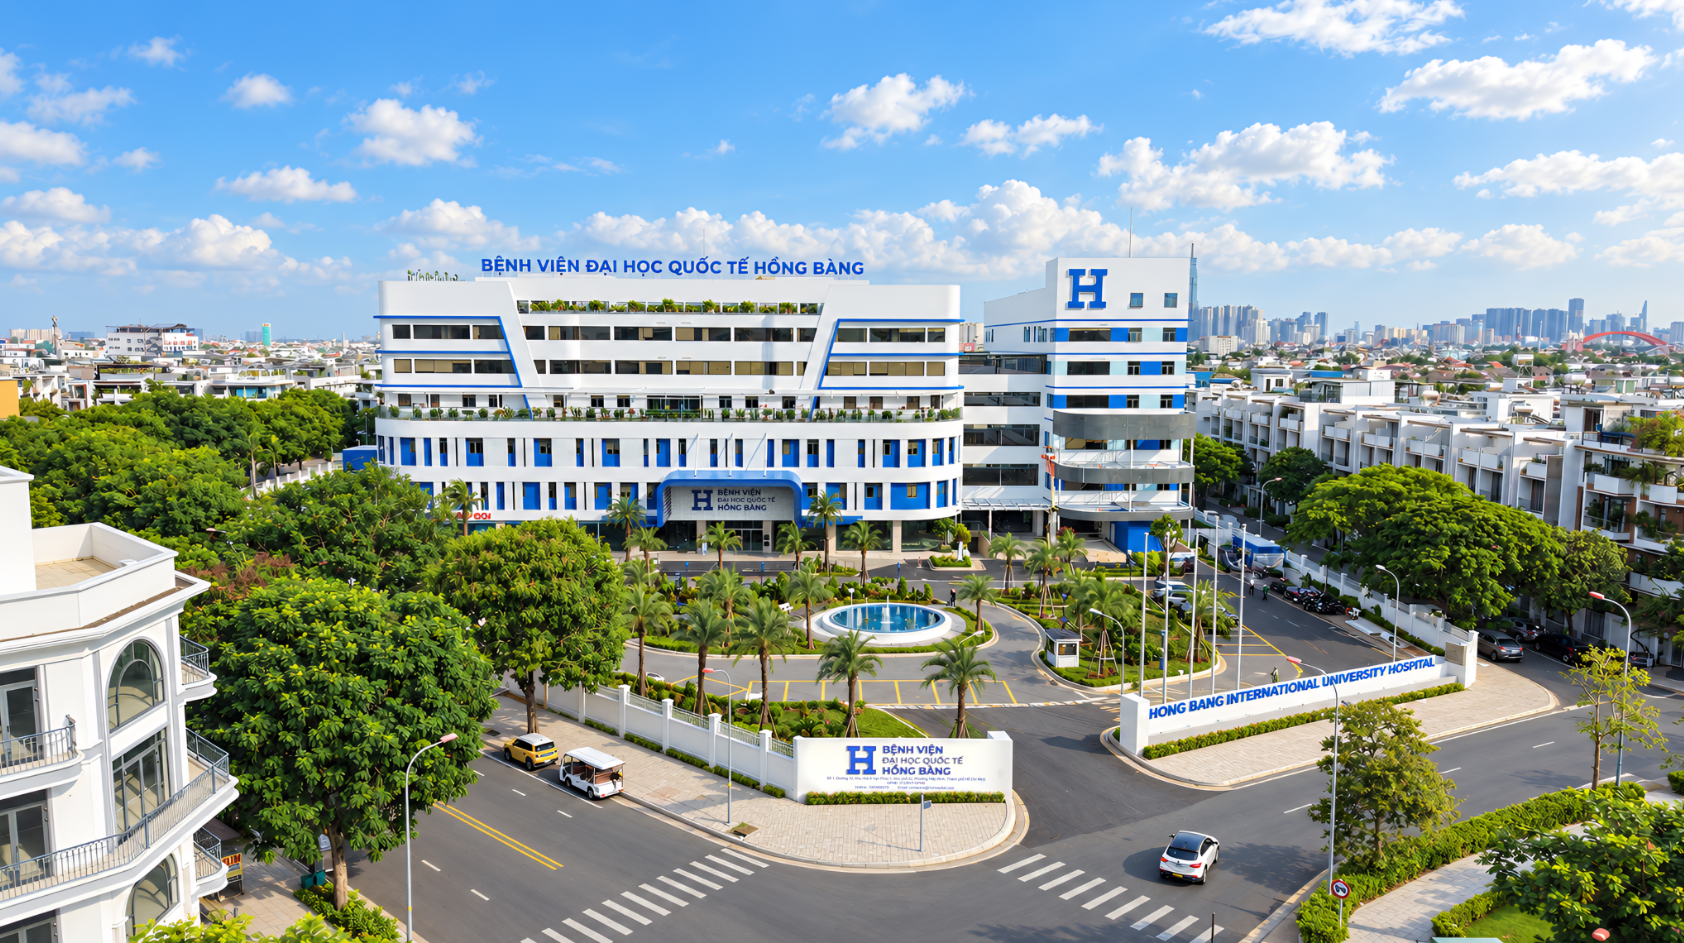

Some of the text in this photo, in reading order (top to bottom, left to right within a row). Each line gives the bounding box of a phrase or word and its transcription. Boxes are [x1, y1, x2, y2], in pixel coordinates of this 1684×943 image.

[481, 255, 864, 277] BỆNH VIỆN ĐẠI HỌC QUỐC TẾ HỒNG BÀNG
[1067, 268, 1108, 310] H
[691, 489, 714, 511] H
[717, 487, 761, 497] BỆNH VIỆN
[1148, 656, 1435, 720] HONG BANG INTERNATIONAL UNIVERSITY HOSPITAL
[846, 745, 877, 775] H
[882, 743, 944, 756] BỆNH VIỆN
